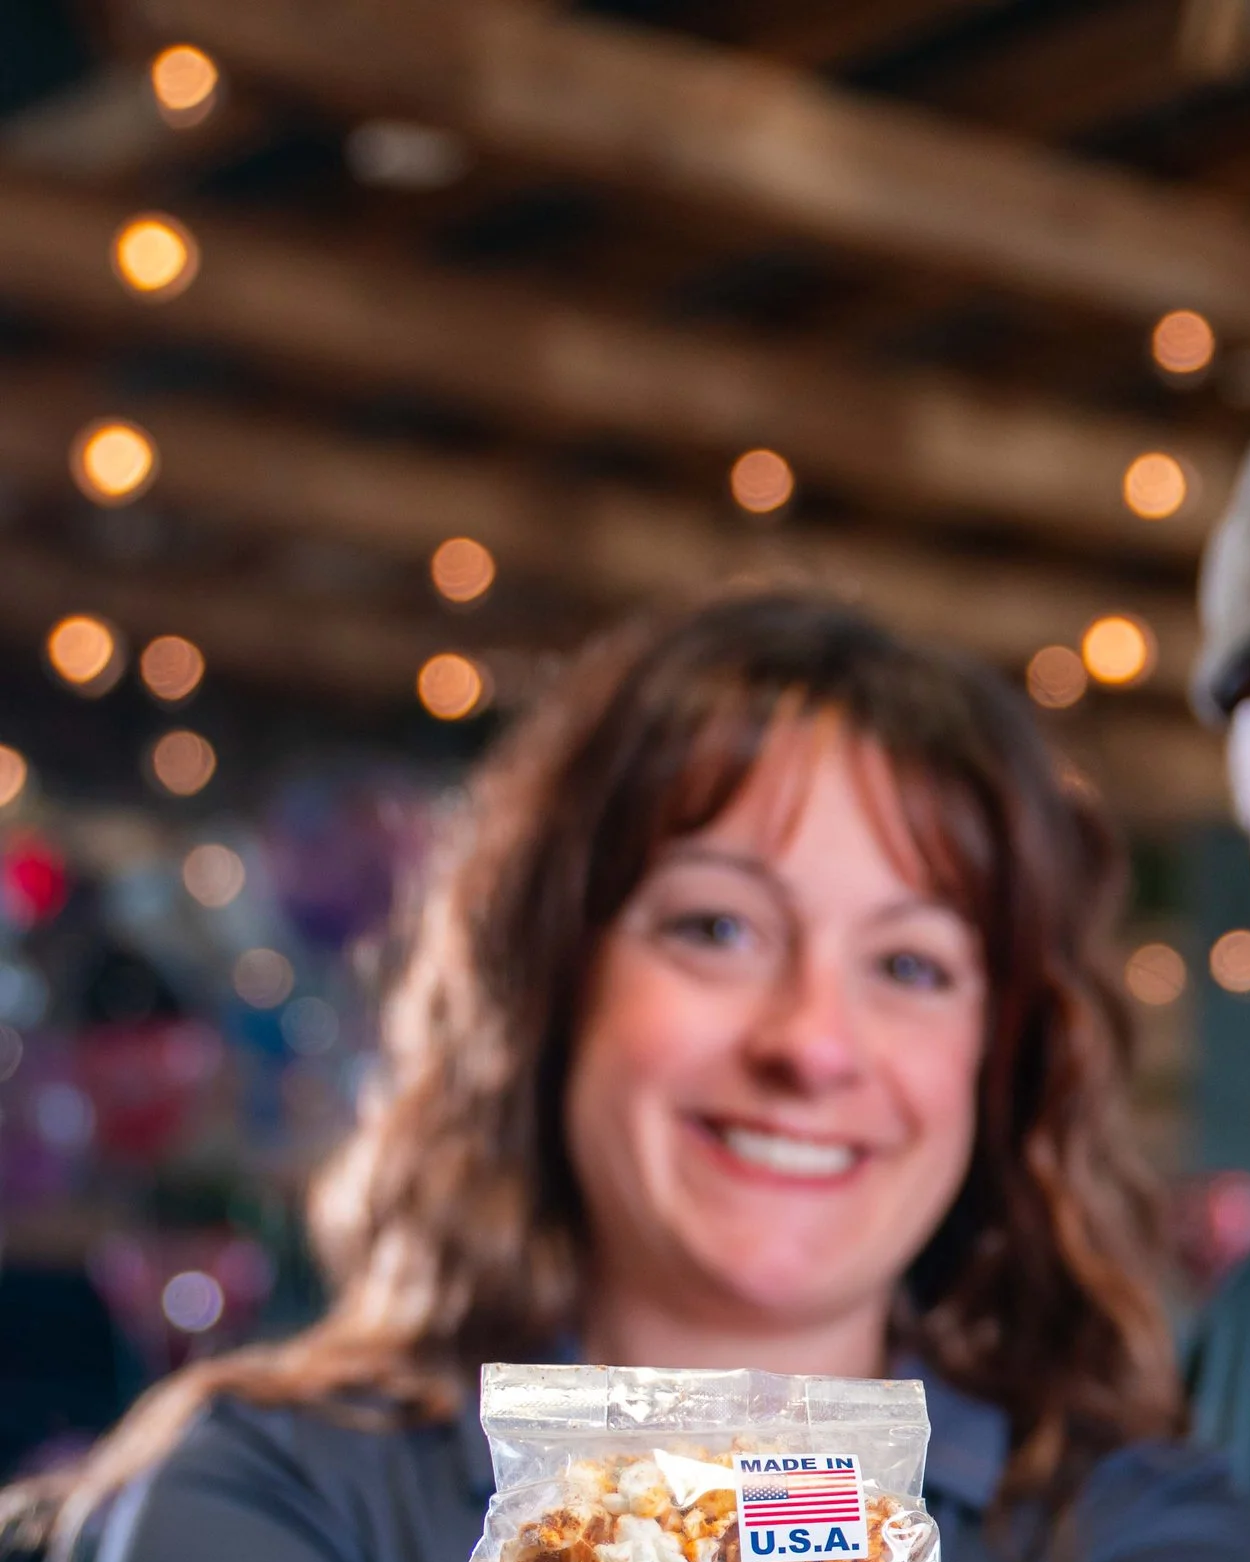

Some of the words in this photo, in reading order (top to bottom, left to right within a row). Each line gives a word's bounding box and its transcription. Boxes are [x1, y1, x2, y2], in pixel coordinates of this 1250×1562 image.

[740, 1458, 817, 1472] MADE
[826, 1458, 854, 1469] IN
[750, 1527, 860, 1555] U.S.A.
